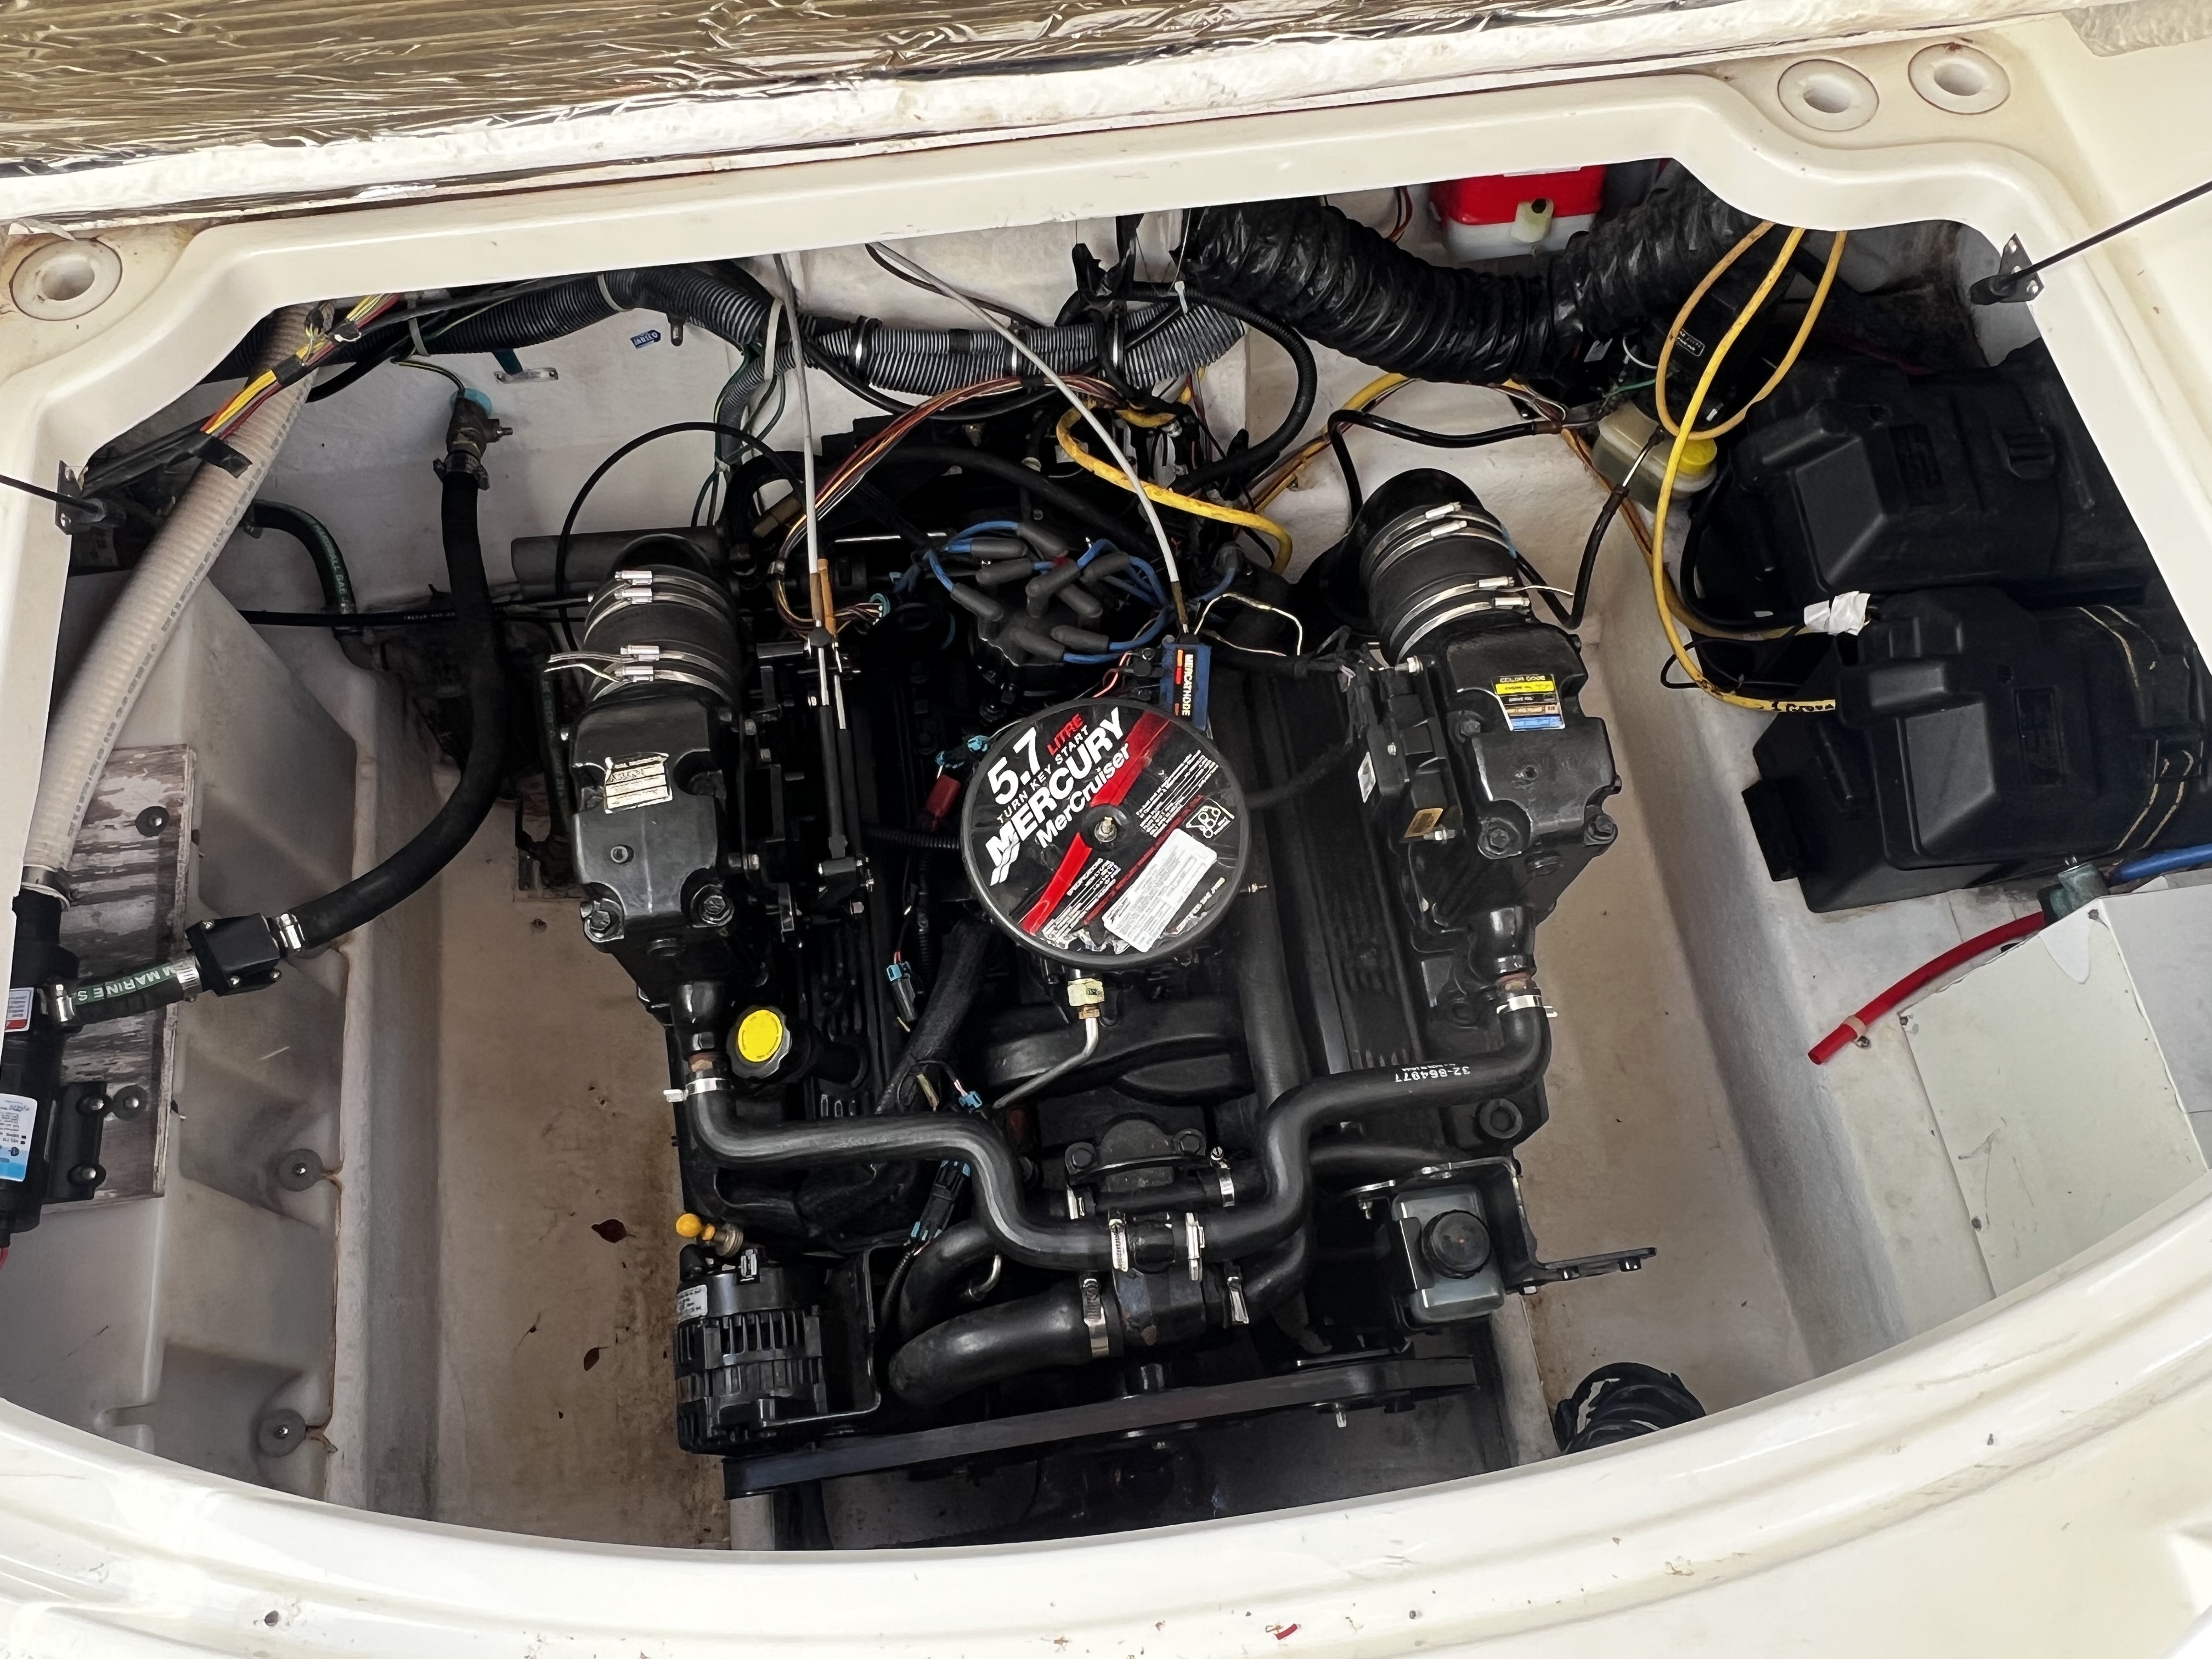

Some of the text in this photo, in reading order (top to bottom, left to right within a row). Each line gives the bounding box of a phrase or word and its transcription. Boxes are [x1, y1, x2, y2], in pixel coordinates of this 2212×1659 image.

[987, 727, 1043, 805] 5.7
[997, 726, 1089, 824] TURN KEY START
[1047, 713, 1084, 755] LITRE
[985, 707, 1126, 868] MERCURY
[1035, 742, 1131, 848] MerCruiser
[92, 969, 160, 998] MARINE
